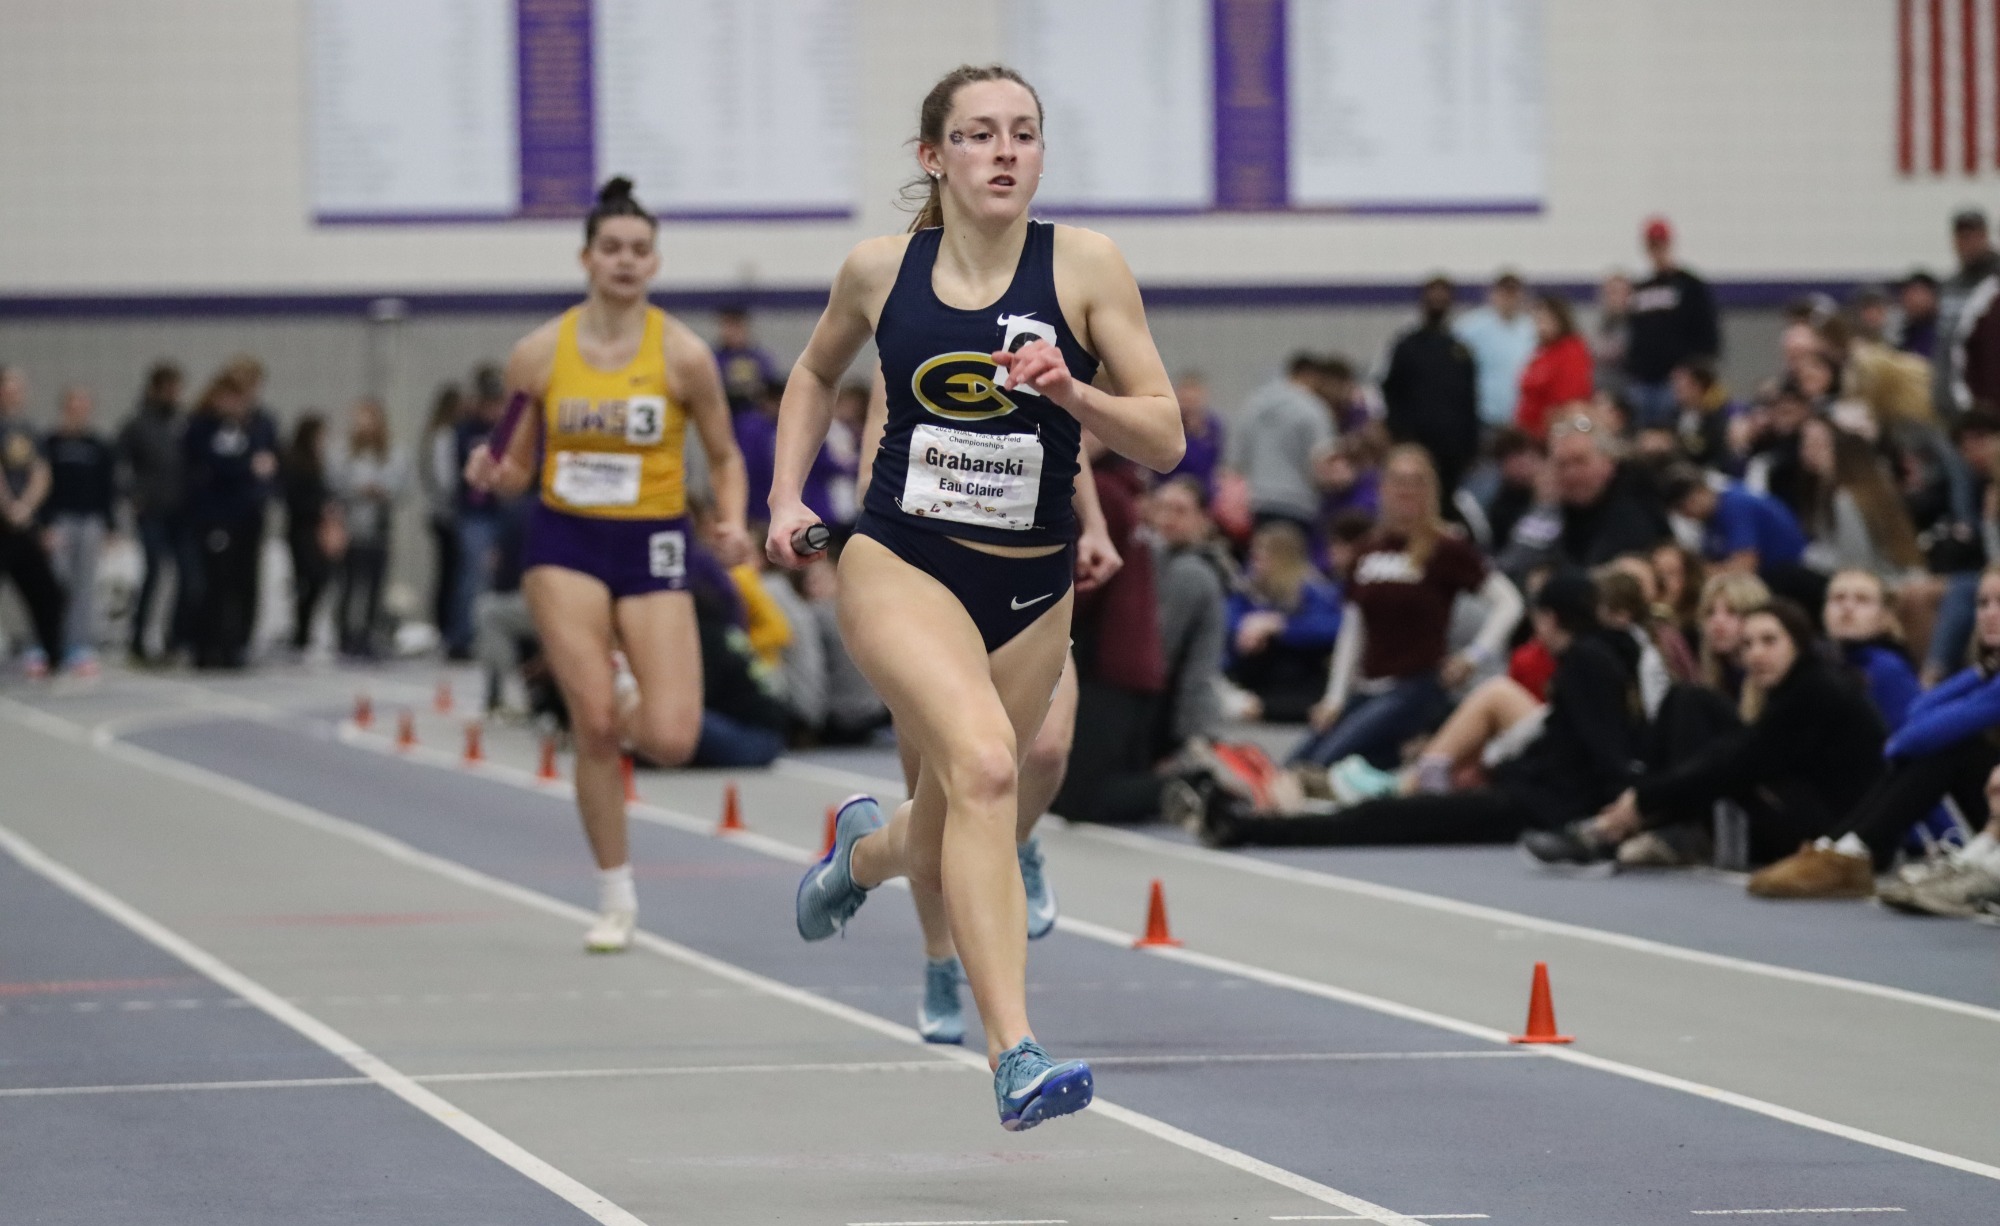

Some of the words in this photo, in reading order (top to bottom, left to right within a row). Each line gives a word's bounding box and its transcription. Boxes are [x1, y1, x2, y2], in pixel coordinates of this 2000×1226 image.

[634, 404, 656, 438] 3
[949, 435, 1005, 450] Championships
[1003, 435, 1022, 443] Field
[925, 446, 1024, 476] Grabarski
[939, 477, 962, 493] Eau
[966, 482, 1004, 498] Claire
[658, 541, 676, 568] 3
